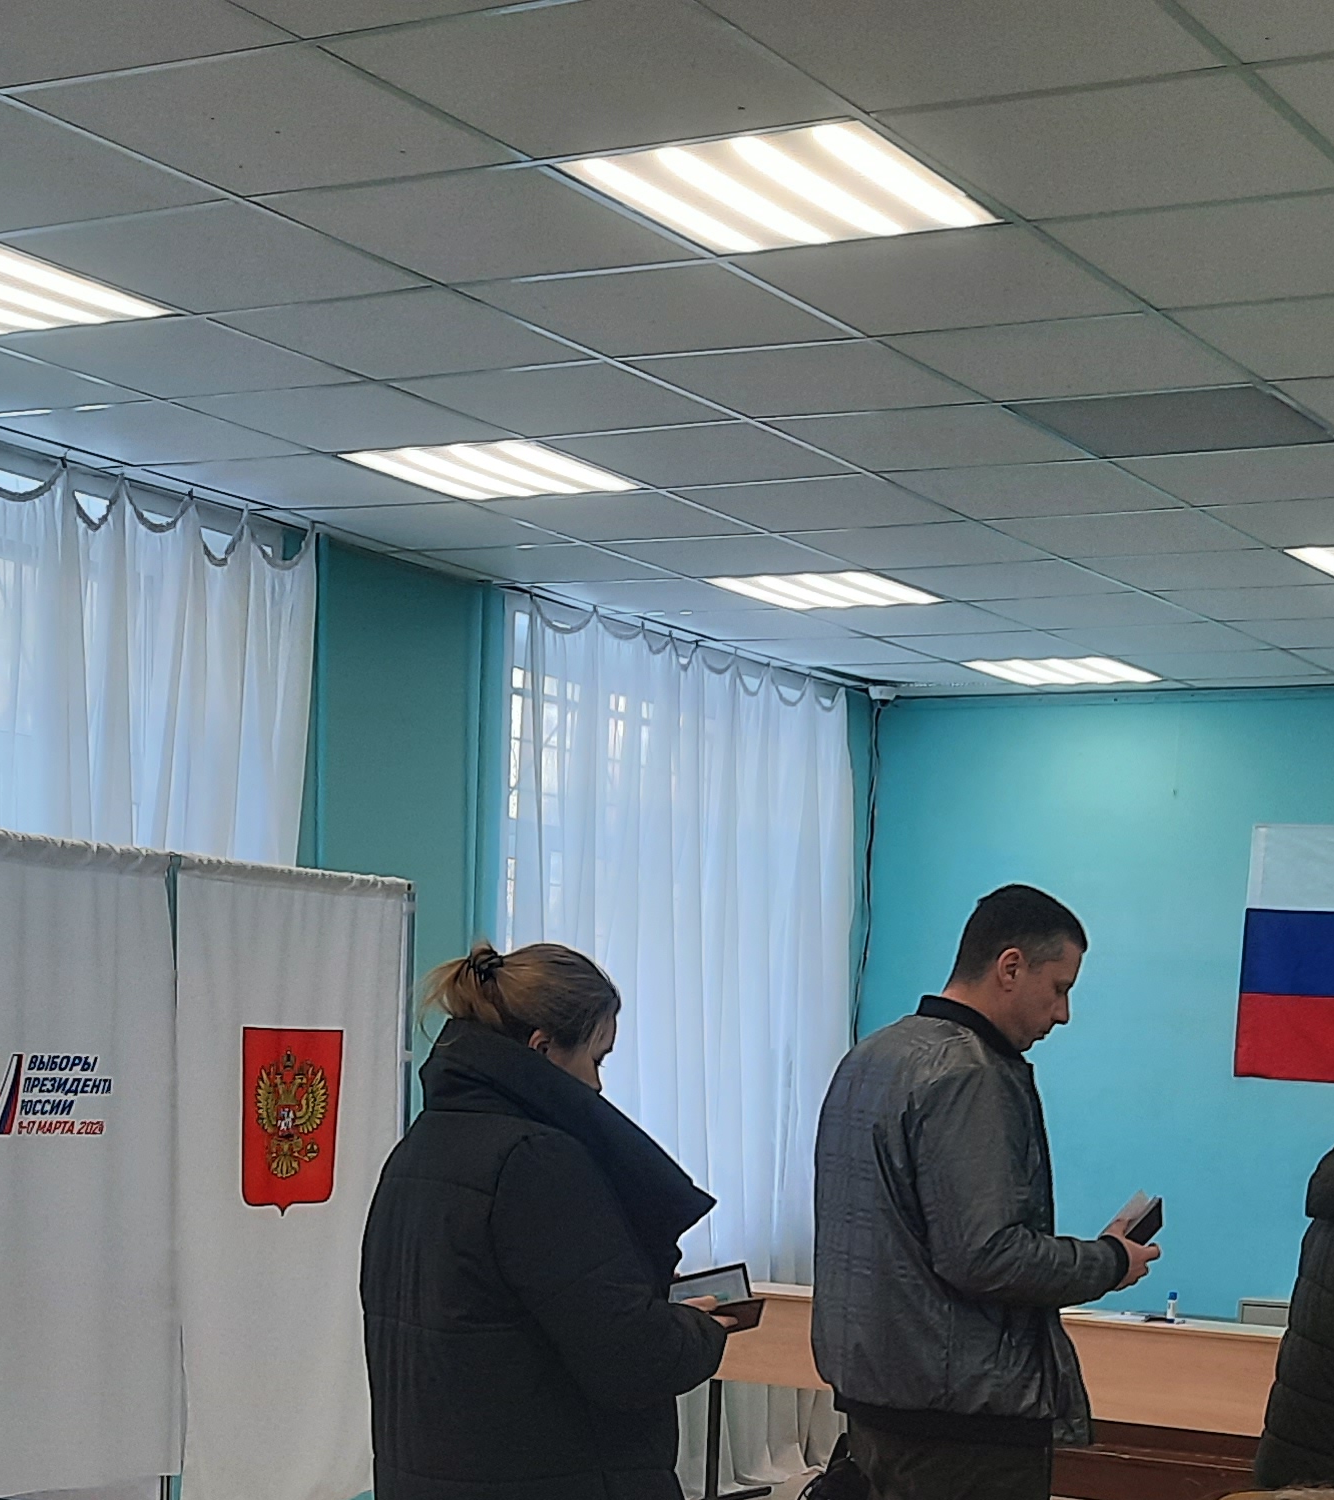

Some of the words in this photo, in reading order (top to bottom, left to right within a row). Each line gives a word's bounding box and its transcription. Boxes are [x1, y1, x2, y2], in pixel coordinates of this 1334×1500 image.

[27, 1054, 99, 1073] ВЫБОРЫ
[22, 1076, 113, 1096] ПРЕЗИДЕНТА
[36, 1120, 74, 1135] МАРТА
